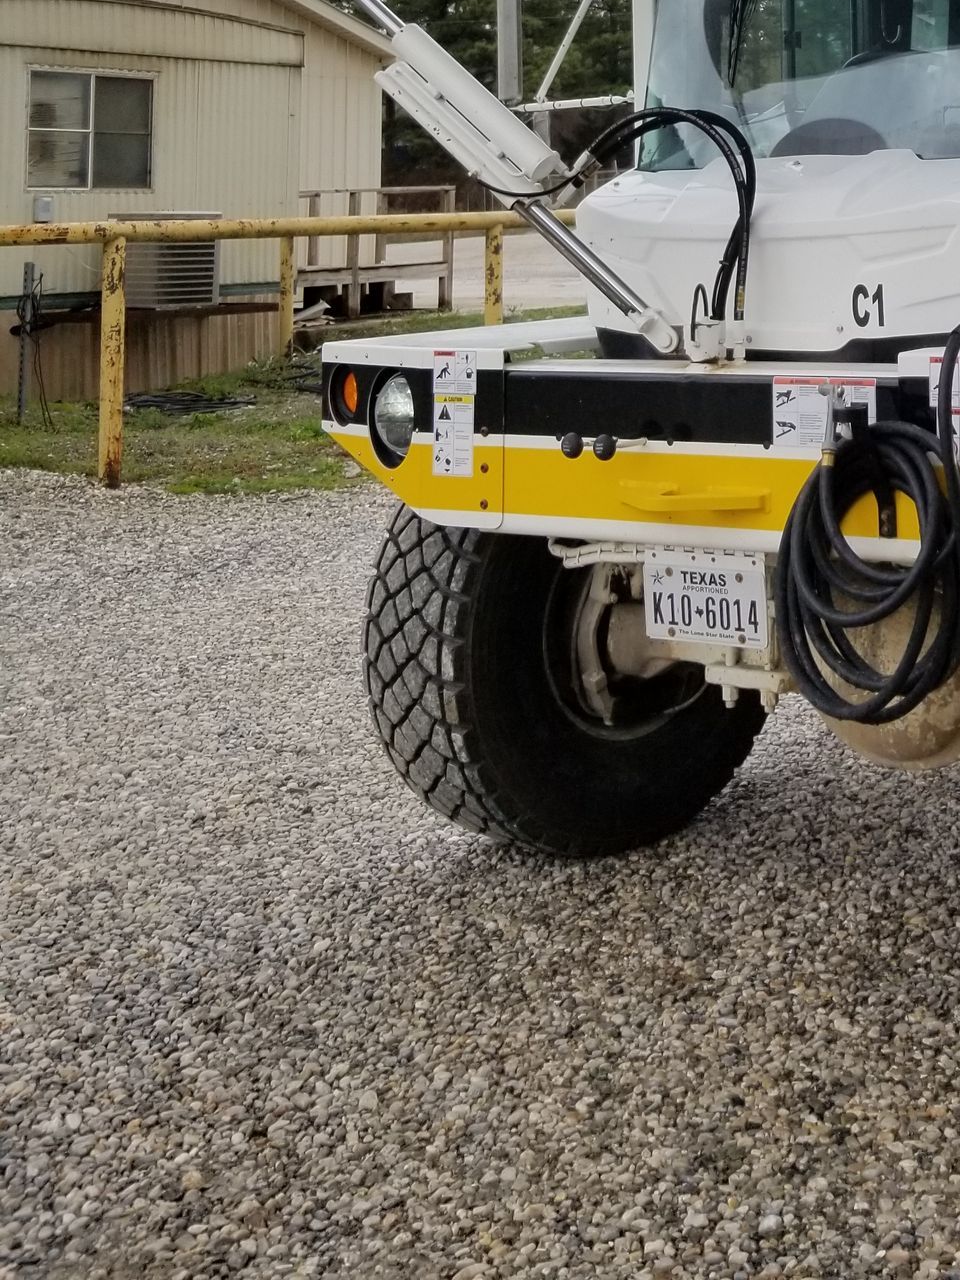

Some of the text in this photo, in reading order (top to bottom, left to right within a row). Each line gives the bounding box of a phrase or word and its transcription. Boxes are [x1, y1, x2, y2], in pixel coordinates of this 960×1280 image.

[852, 283, 885, 328] C1
[680, 570, 727, 586] TEXAS
[682, 585, 729, 595] APPORTIONED
